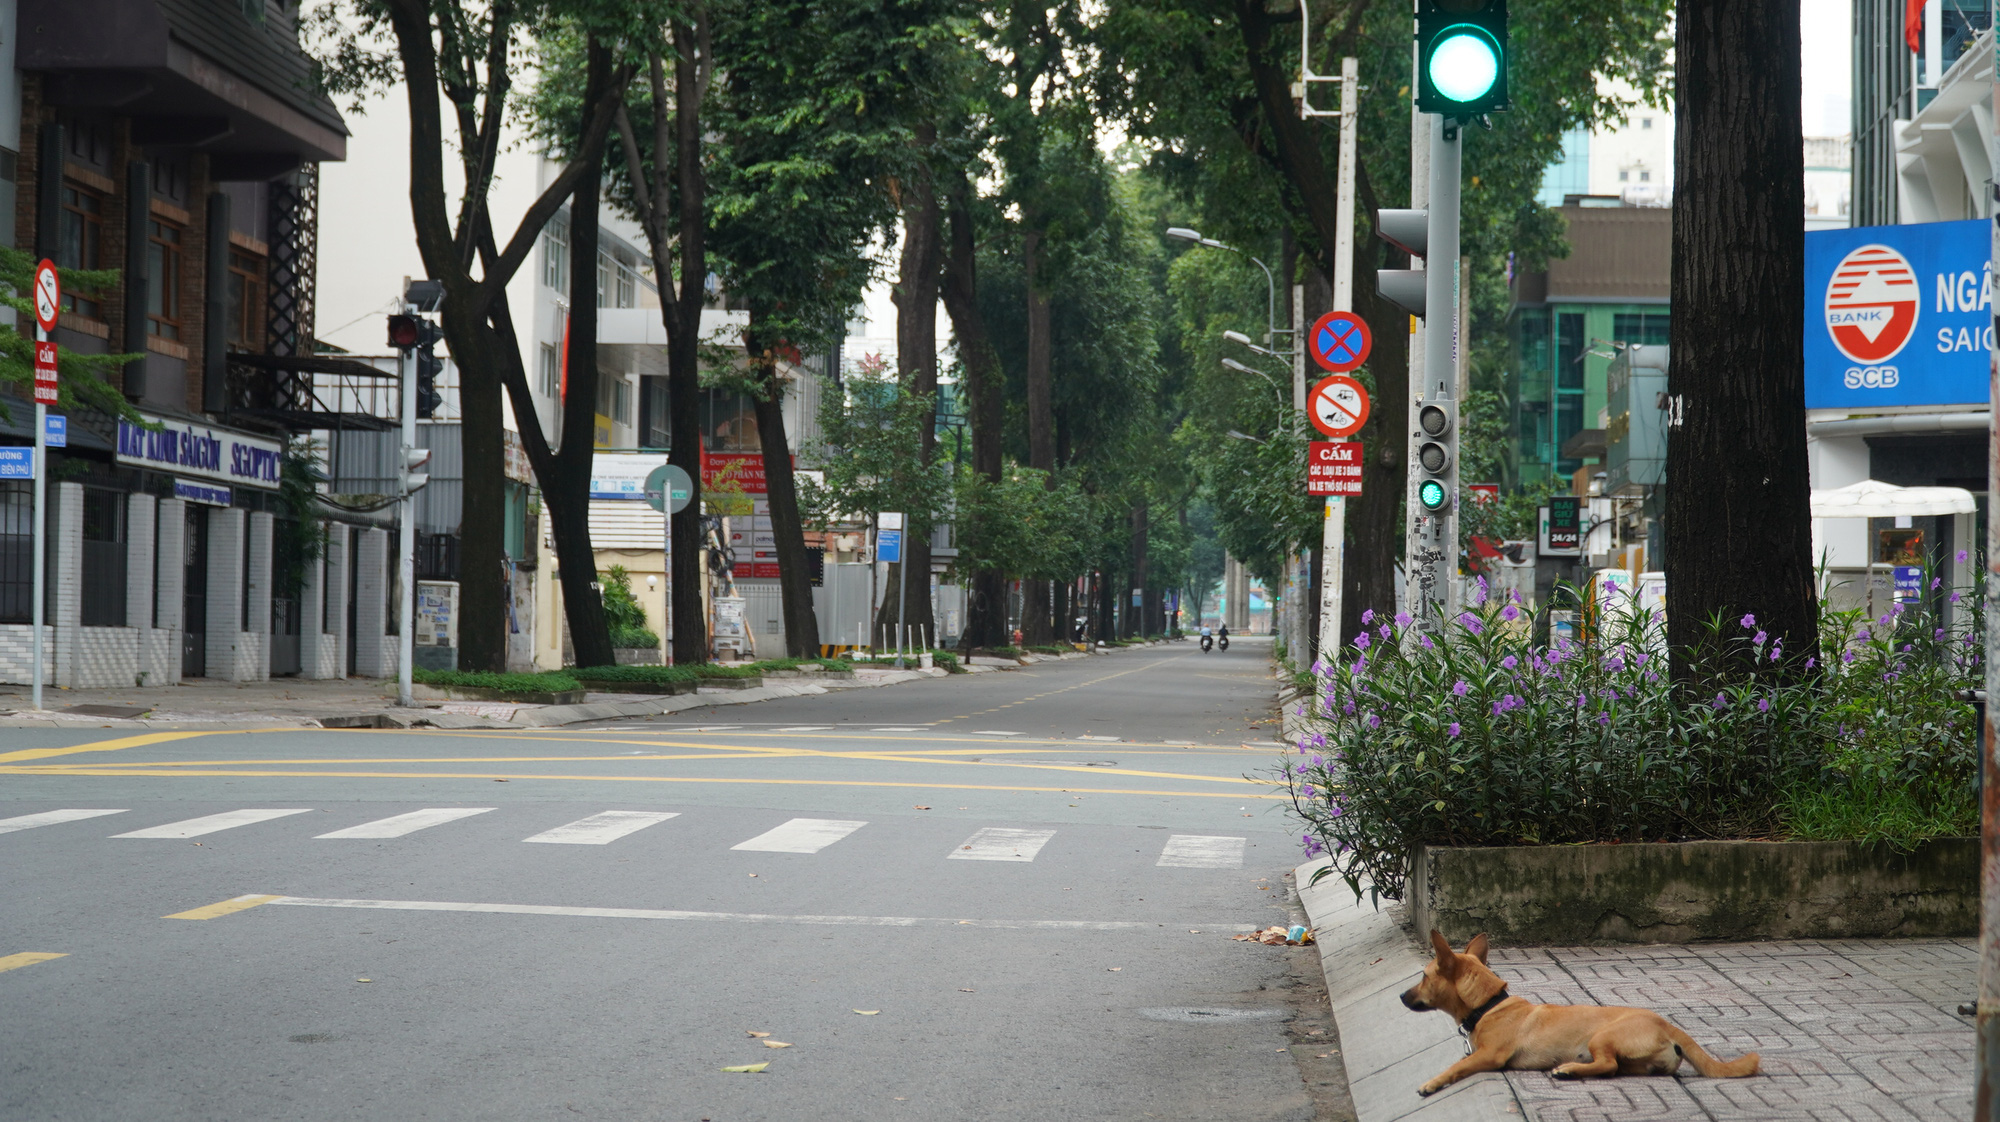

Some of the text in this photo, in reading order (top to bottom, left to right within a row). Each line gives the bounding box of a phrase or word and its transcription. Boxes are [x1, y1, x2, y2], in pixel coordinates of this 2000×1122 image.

[1829, 311, 1882, 324] BANK
[1845, 366, 1899, 389] SCB
[1320, 444, 1353, 461] CẤM
[1310, 462, 1321, 476] CÁC
[1347, 463, 1362, 477] BÁNH
[1551, 533, 1578, 542] 24/24
